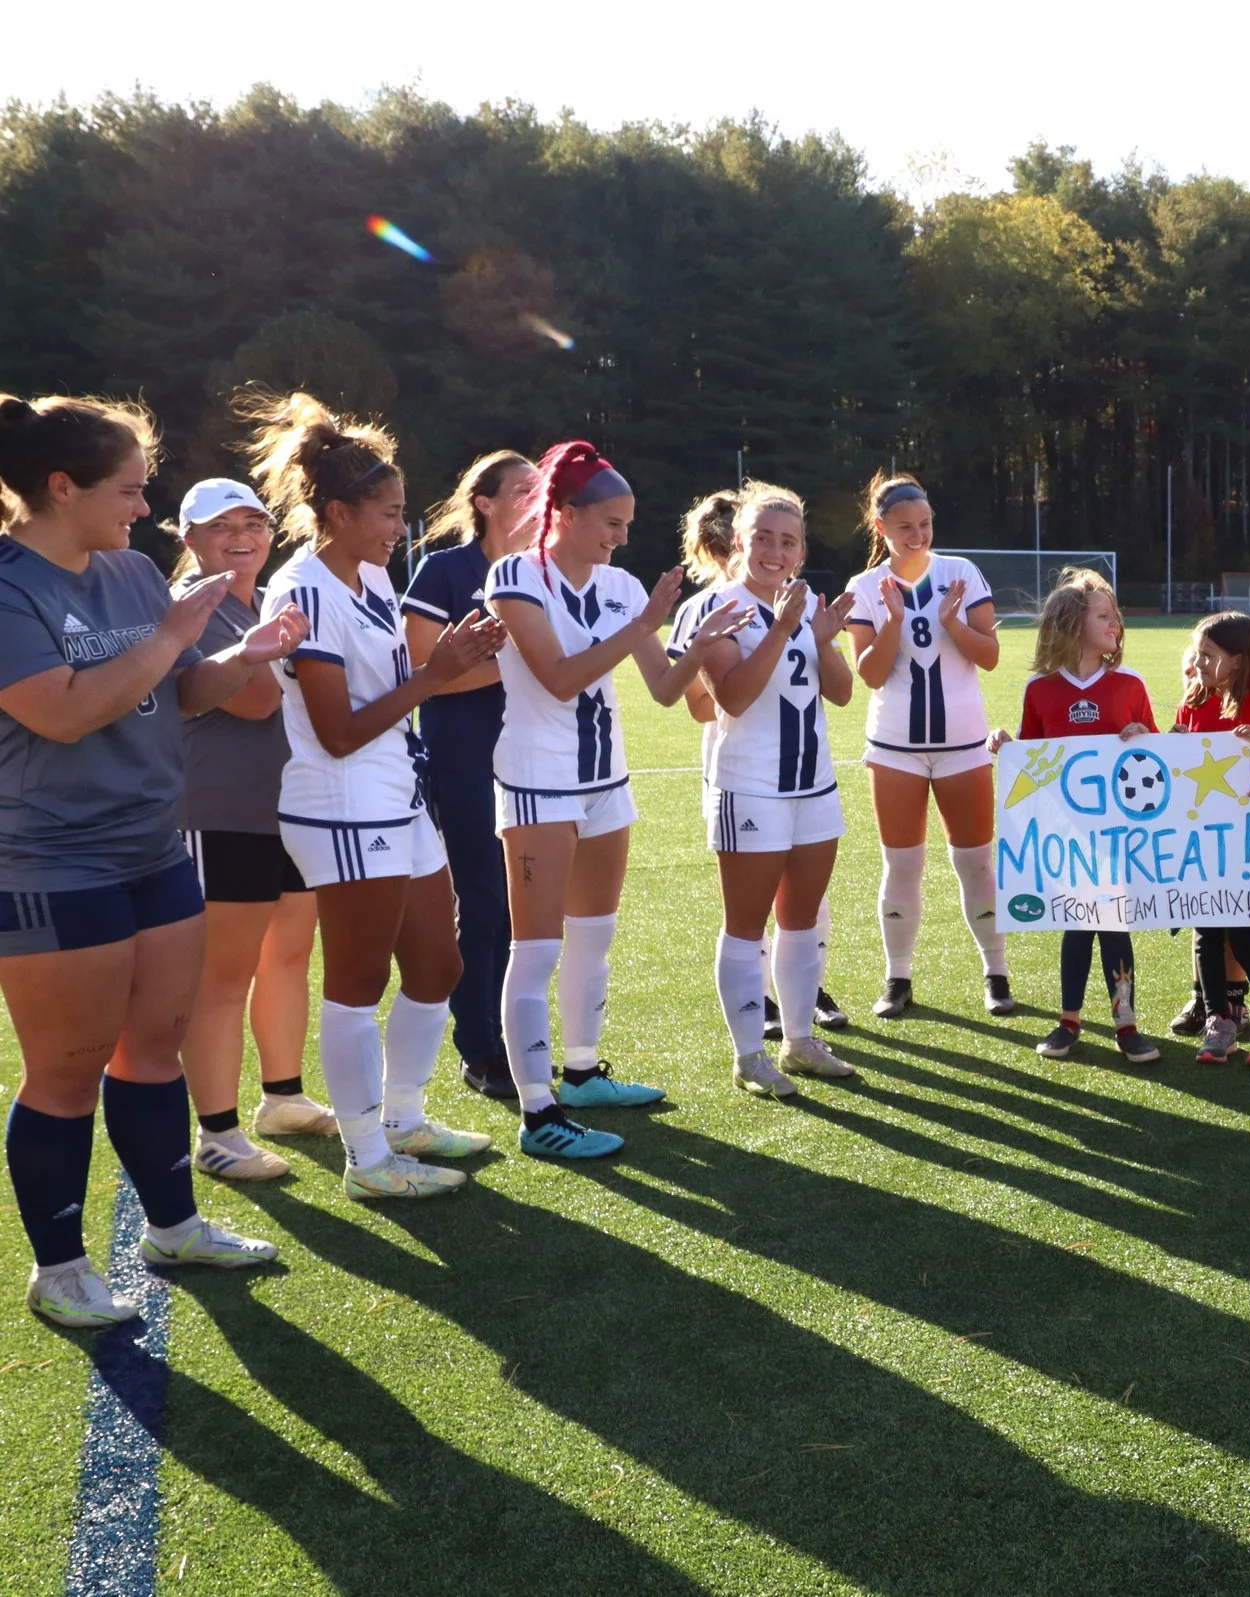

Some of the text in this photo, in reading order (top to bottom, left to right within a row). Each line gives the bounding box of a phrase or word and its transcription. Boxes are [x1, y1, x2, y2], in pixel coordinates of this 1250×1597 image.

[62, 622, 160, 663] MONTRE
[911, 616, 932, 648] 8
[391, 643, 409, 687] 10
[787, 648, 809, 686] 2
[1060, 748, 1171, 821] GO
[1051, 894, 1100, 924] FROM
[1110, 895, 1157, 924] TEAM
